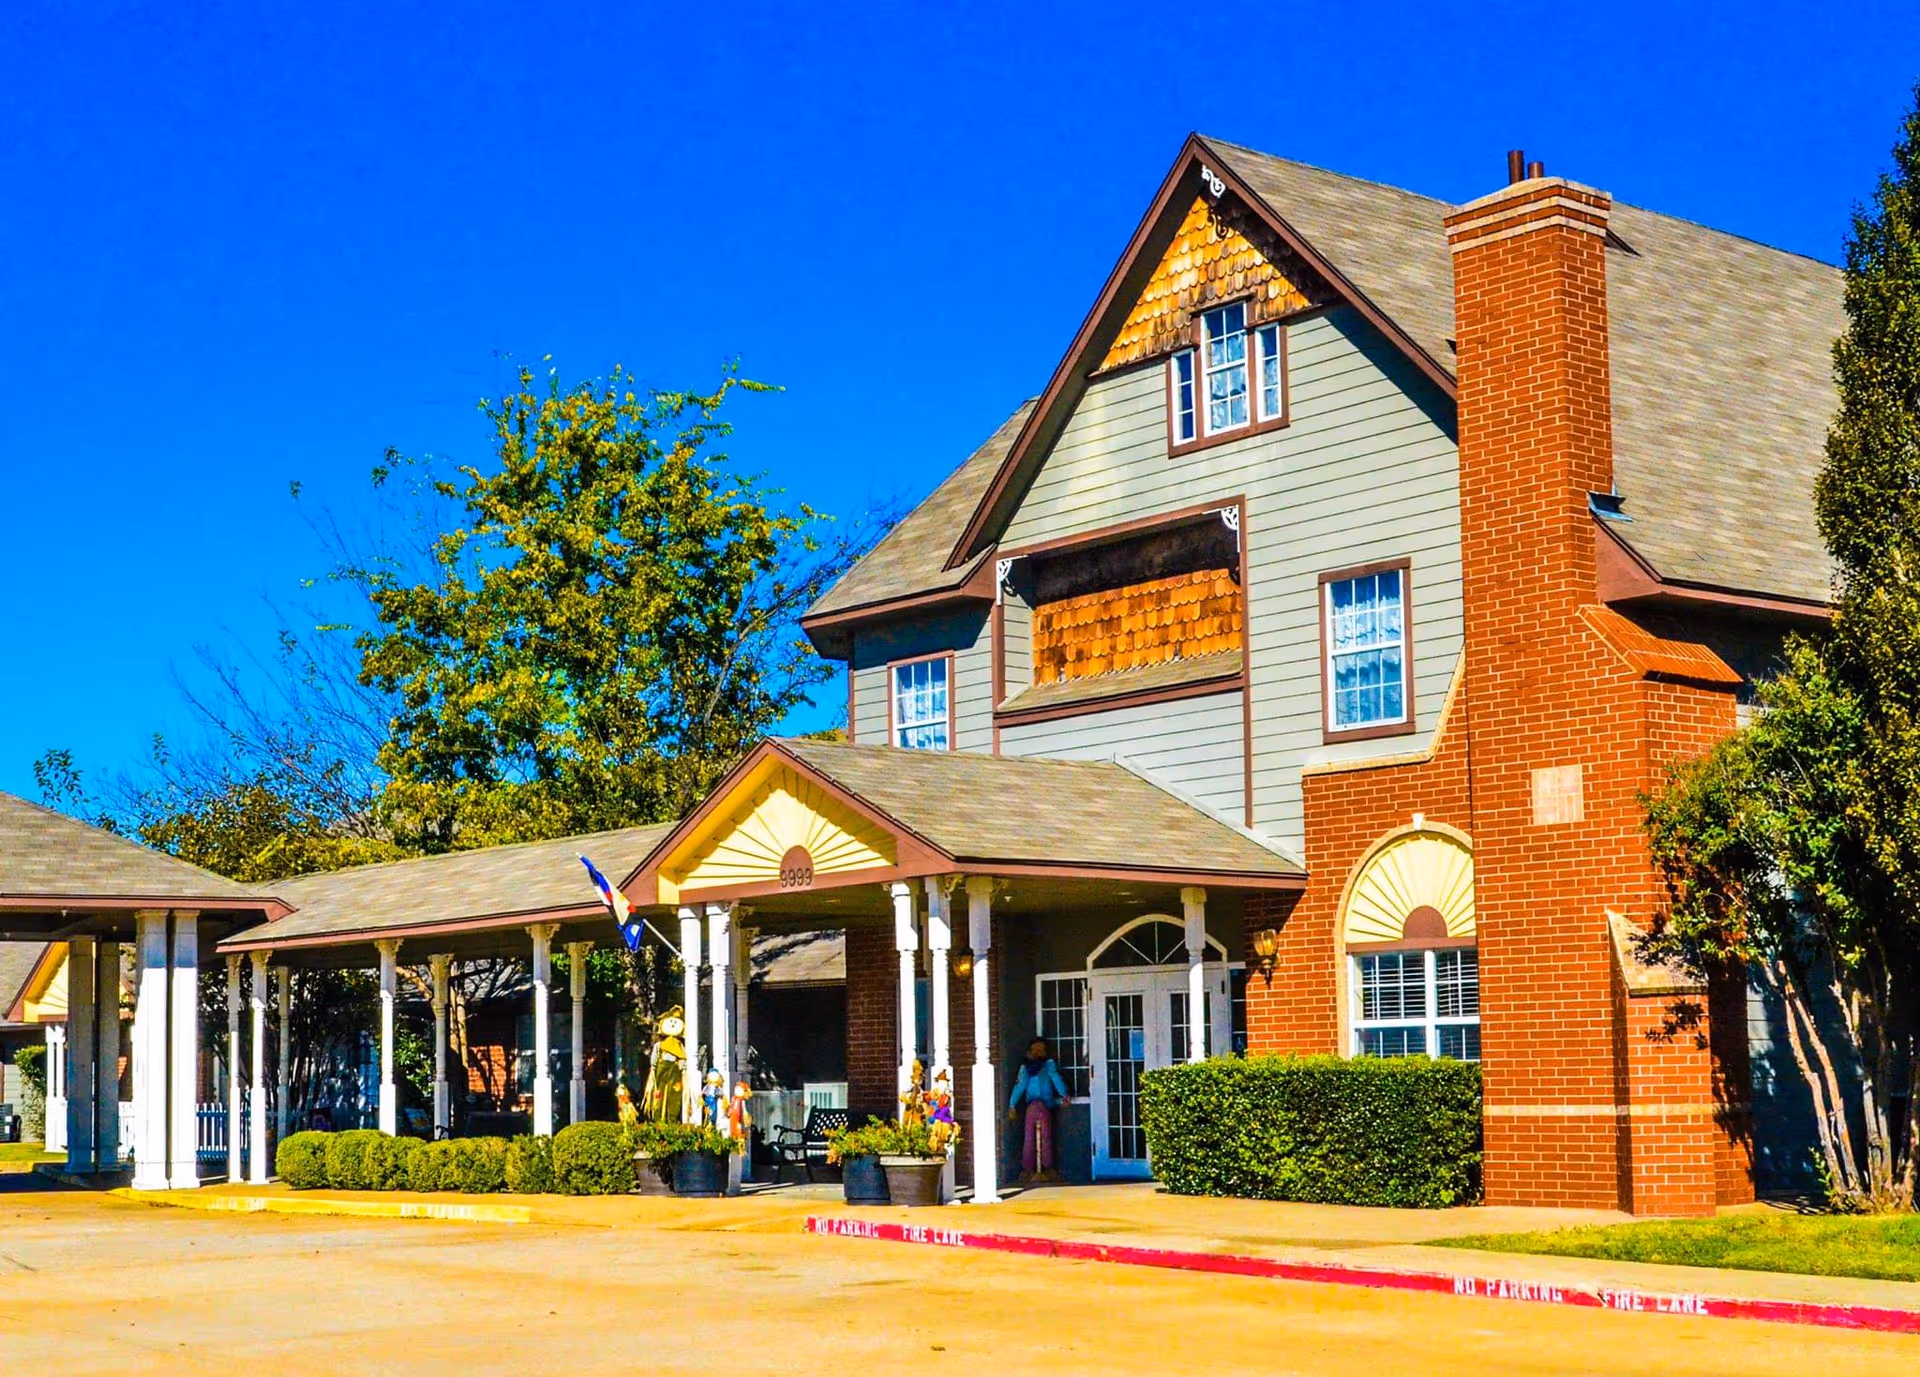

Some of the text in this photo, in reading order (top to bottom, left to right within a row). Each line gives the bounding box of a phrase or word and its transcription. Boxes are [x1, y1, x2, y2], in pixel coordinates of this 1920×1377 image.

[780, 867, 813, 888] 9999
[815, 1217, 965, 1246] NO PARKING FIRE LANE
[1453, 1276, 1709, 1315] NO PARKING FIRE LANE
